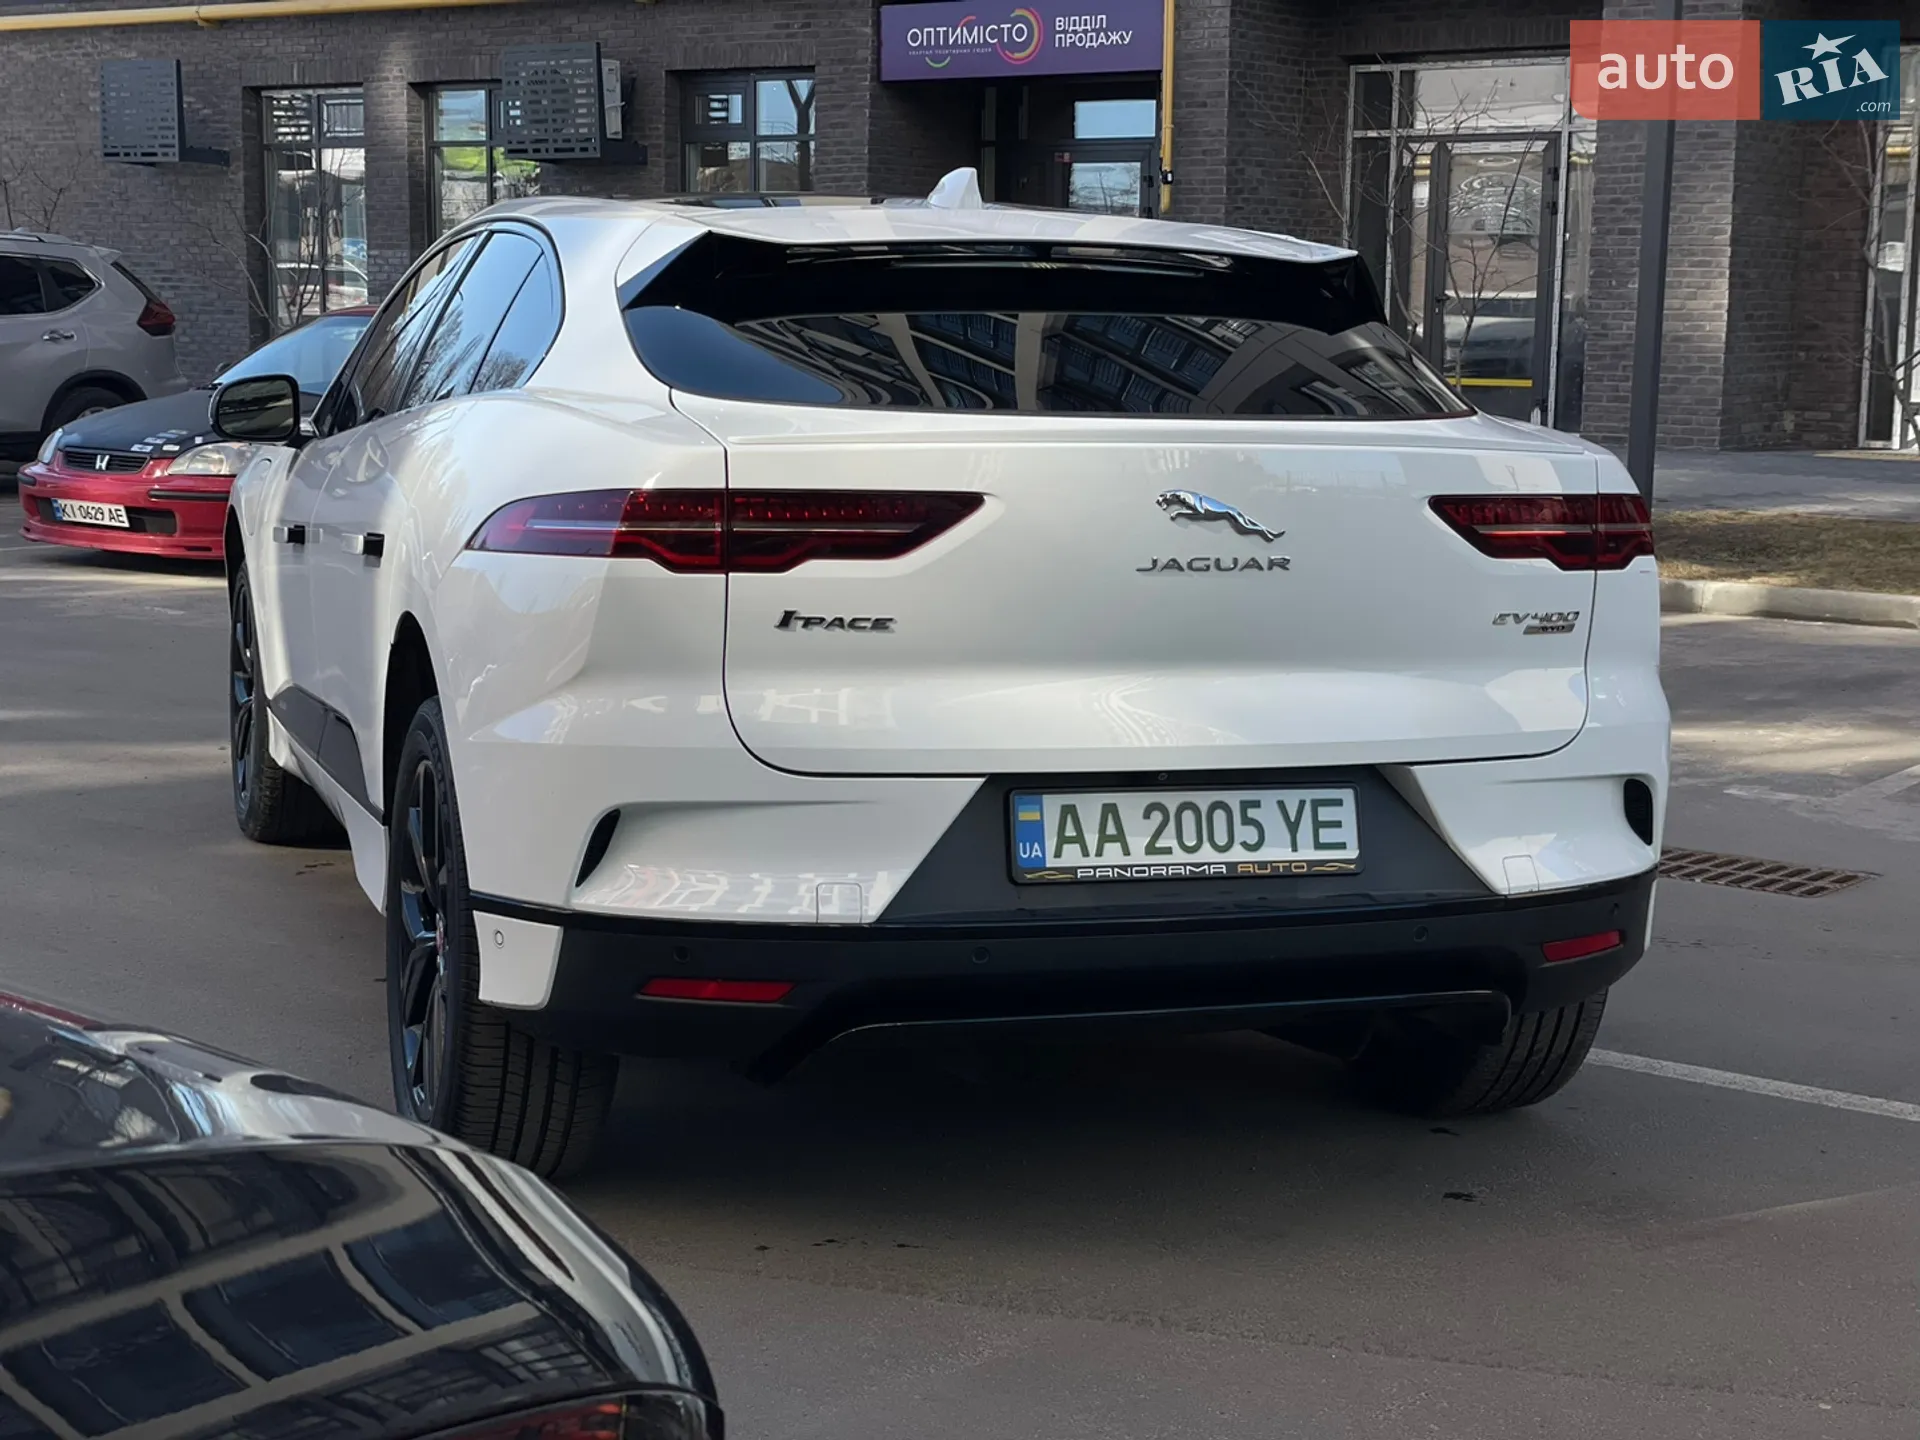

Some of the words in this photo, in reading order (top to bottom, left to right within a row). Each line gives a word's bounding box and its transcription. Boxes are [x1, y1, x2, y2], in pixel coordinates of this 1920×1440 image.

[1055, 15, 1107, 31] ВІДДІЛ
[907, 23, 1028, 47] ОПТИМІСТО
[1055, 30, 1134, 48] ПРОДАЖУ
[108, 508, 125, 524] AE
[1135, 556, 1291, 573] JAGUAR
[1053, 802, 1131, 858] AA
[1142, 800, 1266, 857] 2005
[1277, 798, 1347, 852] YE
[1019, 841, 1043, 858] UA
[1077, 863, 1227, 879] PANORAMA
[1237, 862, 1307, 874] AUTO
